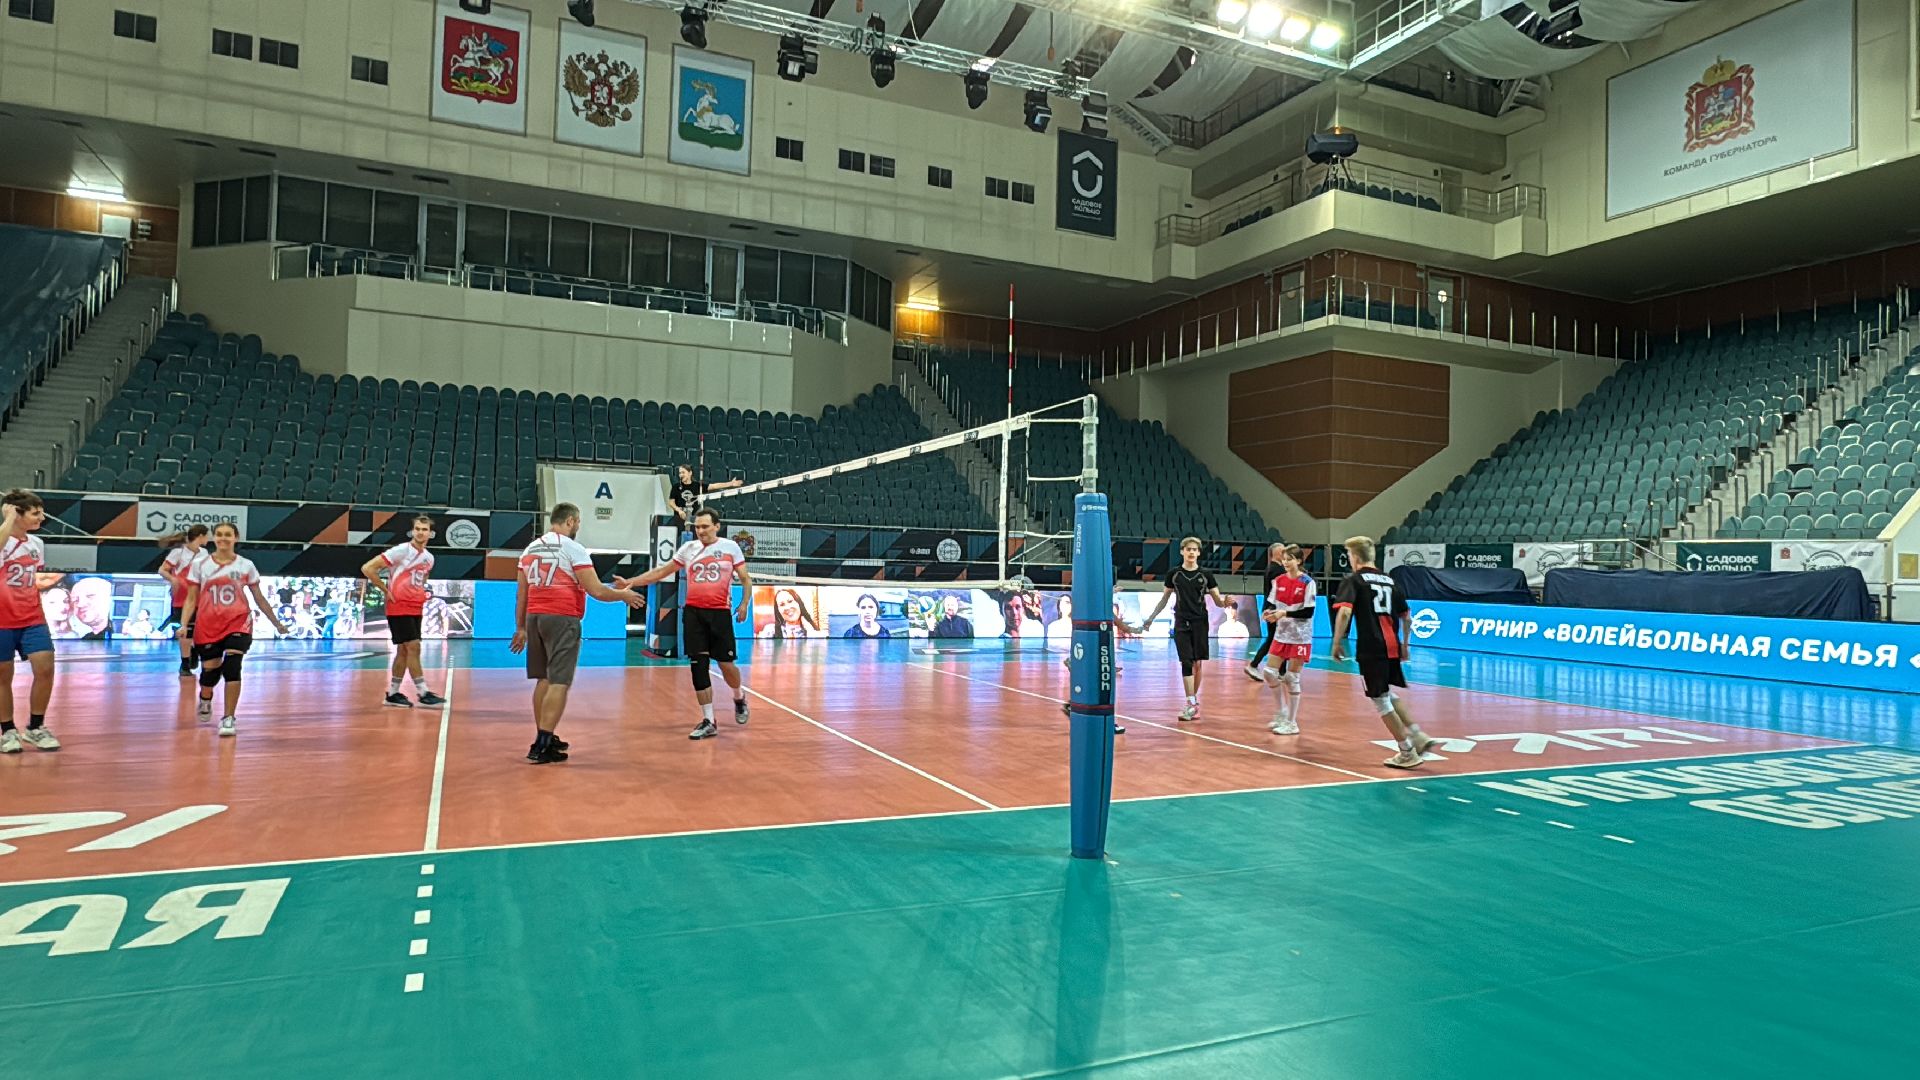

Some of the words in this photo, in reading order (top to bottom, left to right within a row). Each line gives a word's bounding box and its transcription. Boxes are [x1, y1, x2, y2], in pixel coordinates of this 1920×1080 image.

[1663, 157, 1707, 177] КОМАНДА
[1709, 135, 1779, 163] ГУБЕРНАТОРА
[1071, 198, 1102, 209] САДОВОЕ
[1074, 205, 1101, 215] КОЛЬЦО
[173, 513, 238, 524] САДОВОЕ
[1466, 554, 1502, 562] САДОВОЕ
[1705, 555, 1759, 565] САДОВОЕ
[6, 563, 35, 587] 21
[527, 557, 560, 586] 47
[692, 561, 721, 583] 23
[209, 584, 236, 606] 16
[1297, 645, 1308, 656] 21
[1459, 617, 1538, 639] ТУРНИР
[1543, 623, 1772, 658] «ВОЛЕЙБОЛЬНАЯ
[1779, 637, 1899, 669] СЕМЬЯ
